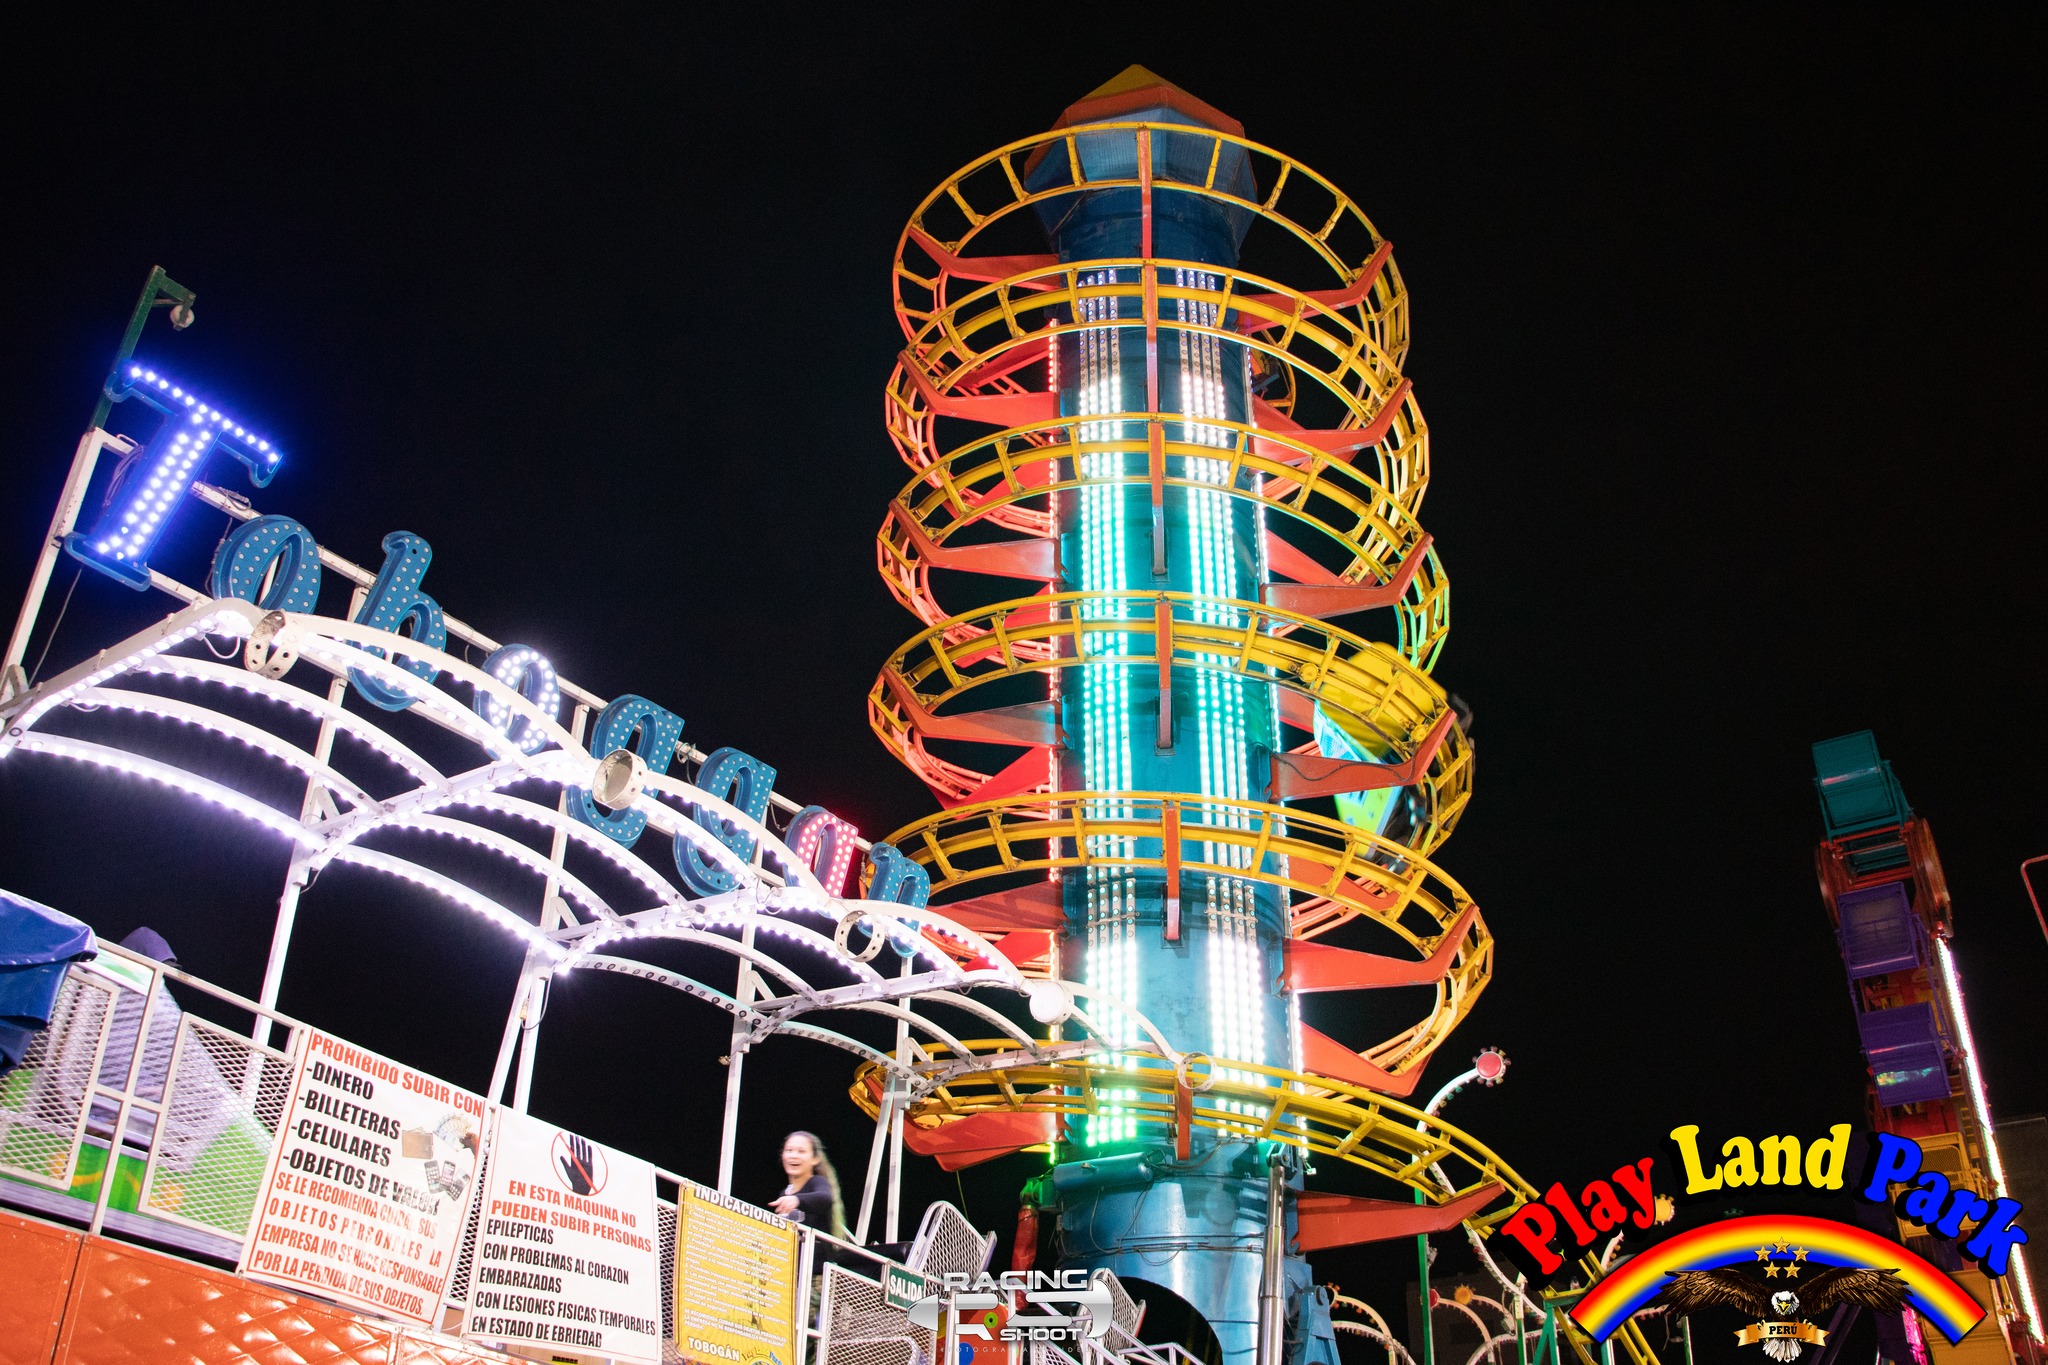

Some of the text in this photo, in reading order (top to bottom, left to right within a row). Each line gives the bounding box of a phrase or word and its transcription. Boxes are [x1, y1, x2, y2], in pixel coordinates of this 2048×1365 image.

[305, 1060, 375, 1101] -DINERO
[310, 1032, 482, 1117] PROHIBIDO SUBIR CON
[298, 1088, 401, 1141] -BILLETERAS
[290, 1118, 392, 1168] -CELULARES
[275, 1171, 294, 1192] SE
[292, 1175, 309, 1196] LE
[307, 1180, 379, 1219] RECOMIENDA
[418, 1218, 437, 1240] SUS
[282, 1147, 440, 1216] -OBJETOS DE VALOR
[508, 1179, 636, 1229] EN ESTA MAQUINA NO
[268, 1197, 338, 1232] OBJETOS
[428, 1250, 442, 1268] LA
[487, 1218, 554, 1245] EPILEPTICAS
[491, 1200, 652, 1253] PUEDEN SUBIR PERSONAS
[693, 1187, 787, 1230] INDICACIONES
[252, 1249, 424, 1316] POR LA PERDIDA DE SUS OBJETOS.
[260, 1223, 320, 1254] EMPRESA
[320, 1238, 338, 1259] NO
[353, 1248, 379, 1273] HACE
[379, 1258, 444, 1297] RESPONSABLE
[478, 1266, 562, 1294] EMBARAZADAS
[482, 1242, 629, 1286] CON PROBLEMAS AL CORAZON
[475, 1290, 502, 1310] CON
[502, 1293, 556, 1317] LESIONES
[556, 1301, 597, 1324] FISICAS
[598, 1309, 656, 1336] TEMPORALES
[890, 1274, 923, 1302] SALIDA
[471, 1315, 602, 1348] EN ESTADO DE EBRIEDAD
[688, 1337, 740, 1361] TOBOGÁN
